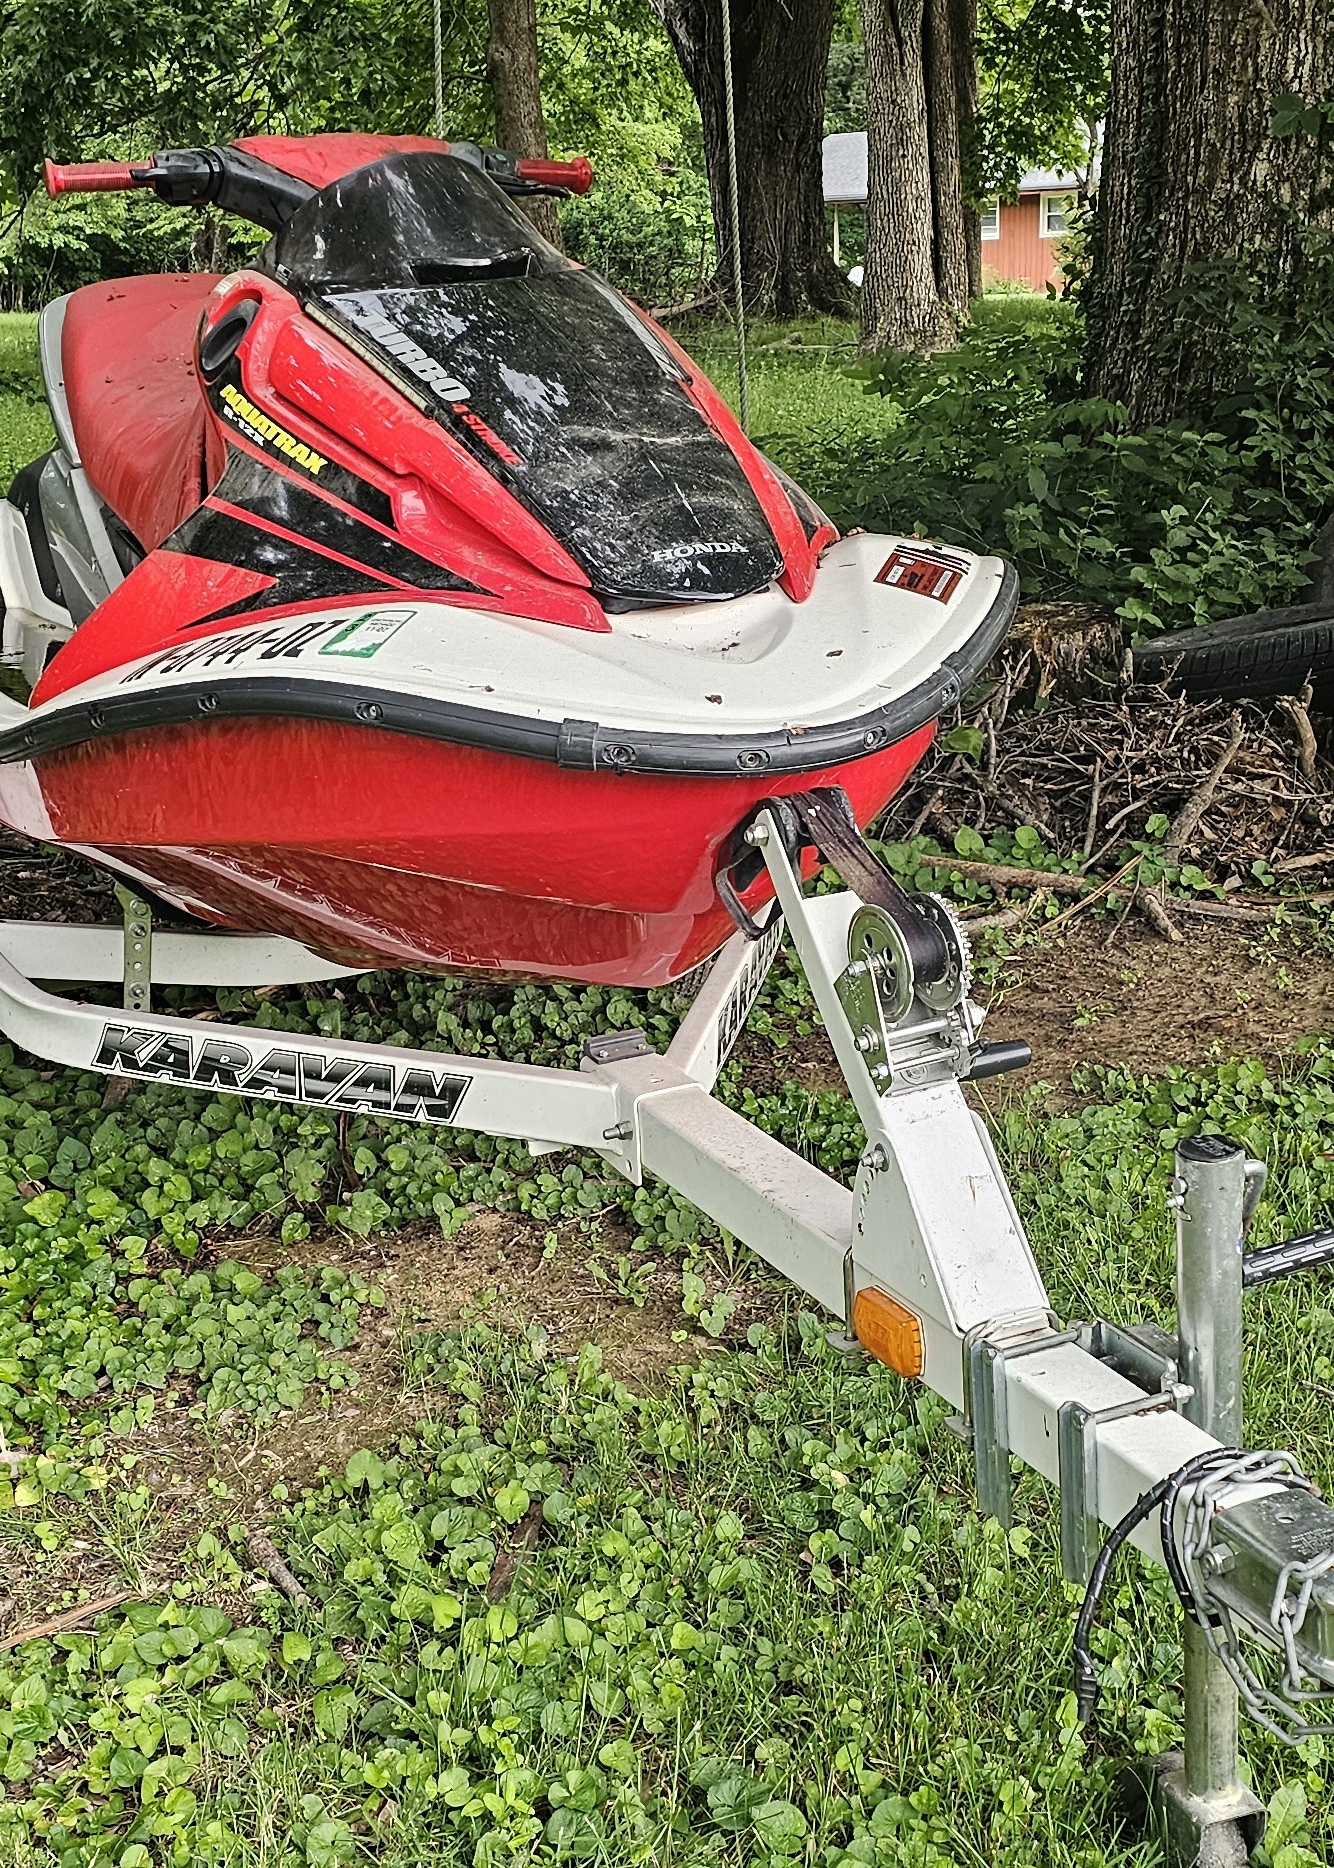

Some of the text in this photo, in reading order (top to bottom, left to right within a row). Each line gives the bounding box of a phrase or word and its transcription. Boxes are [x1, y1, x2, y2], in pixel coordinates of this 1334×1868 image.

[354, 307, 471, 402] TURBO
[219, 383, 328, 475] AQUATRAX
[651, 540, 750, 563] HONDA
[91, 1023, 474, 1124] KARAVAN
